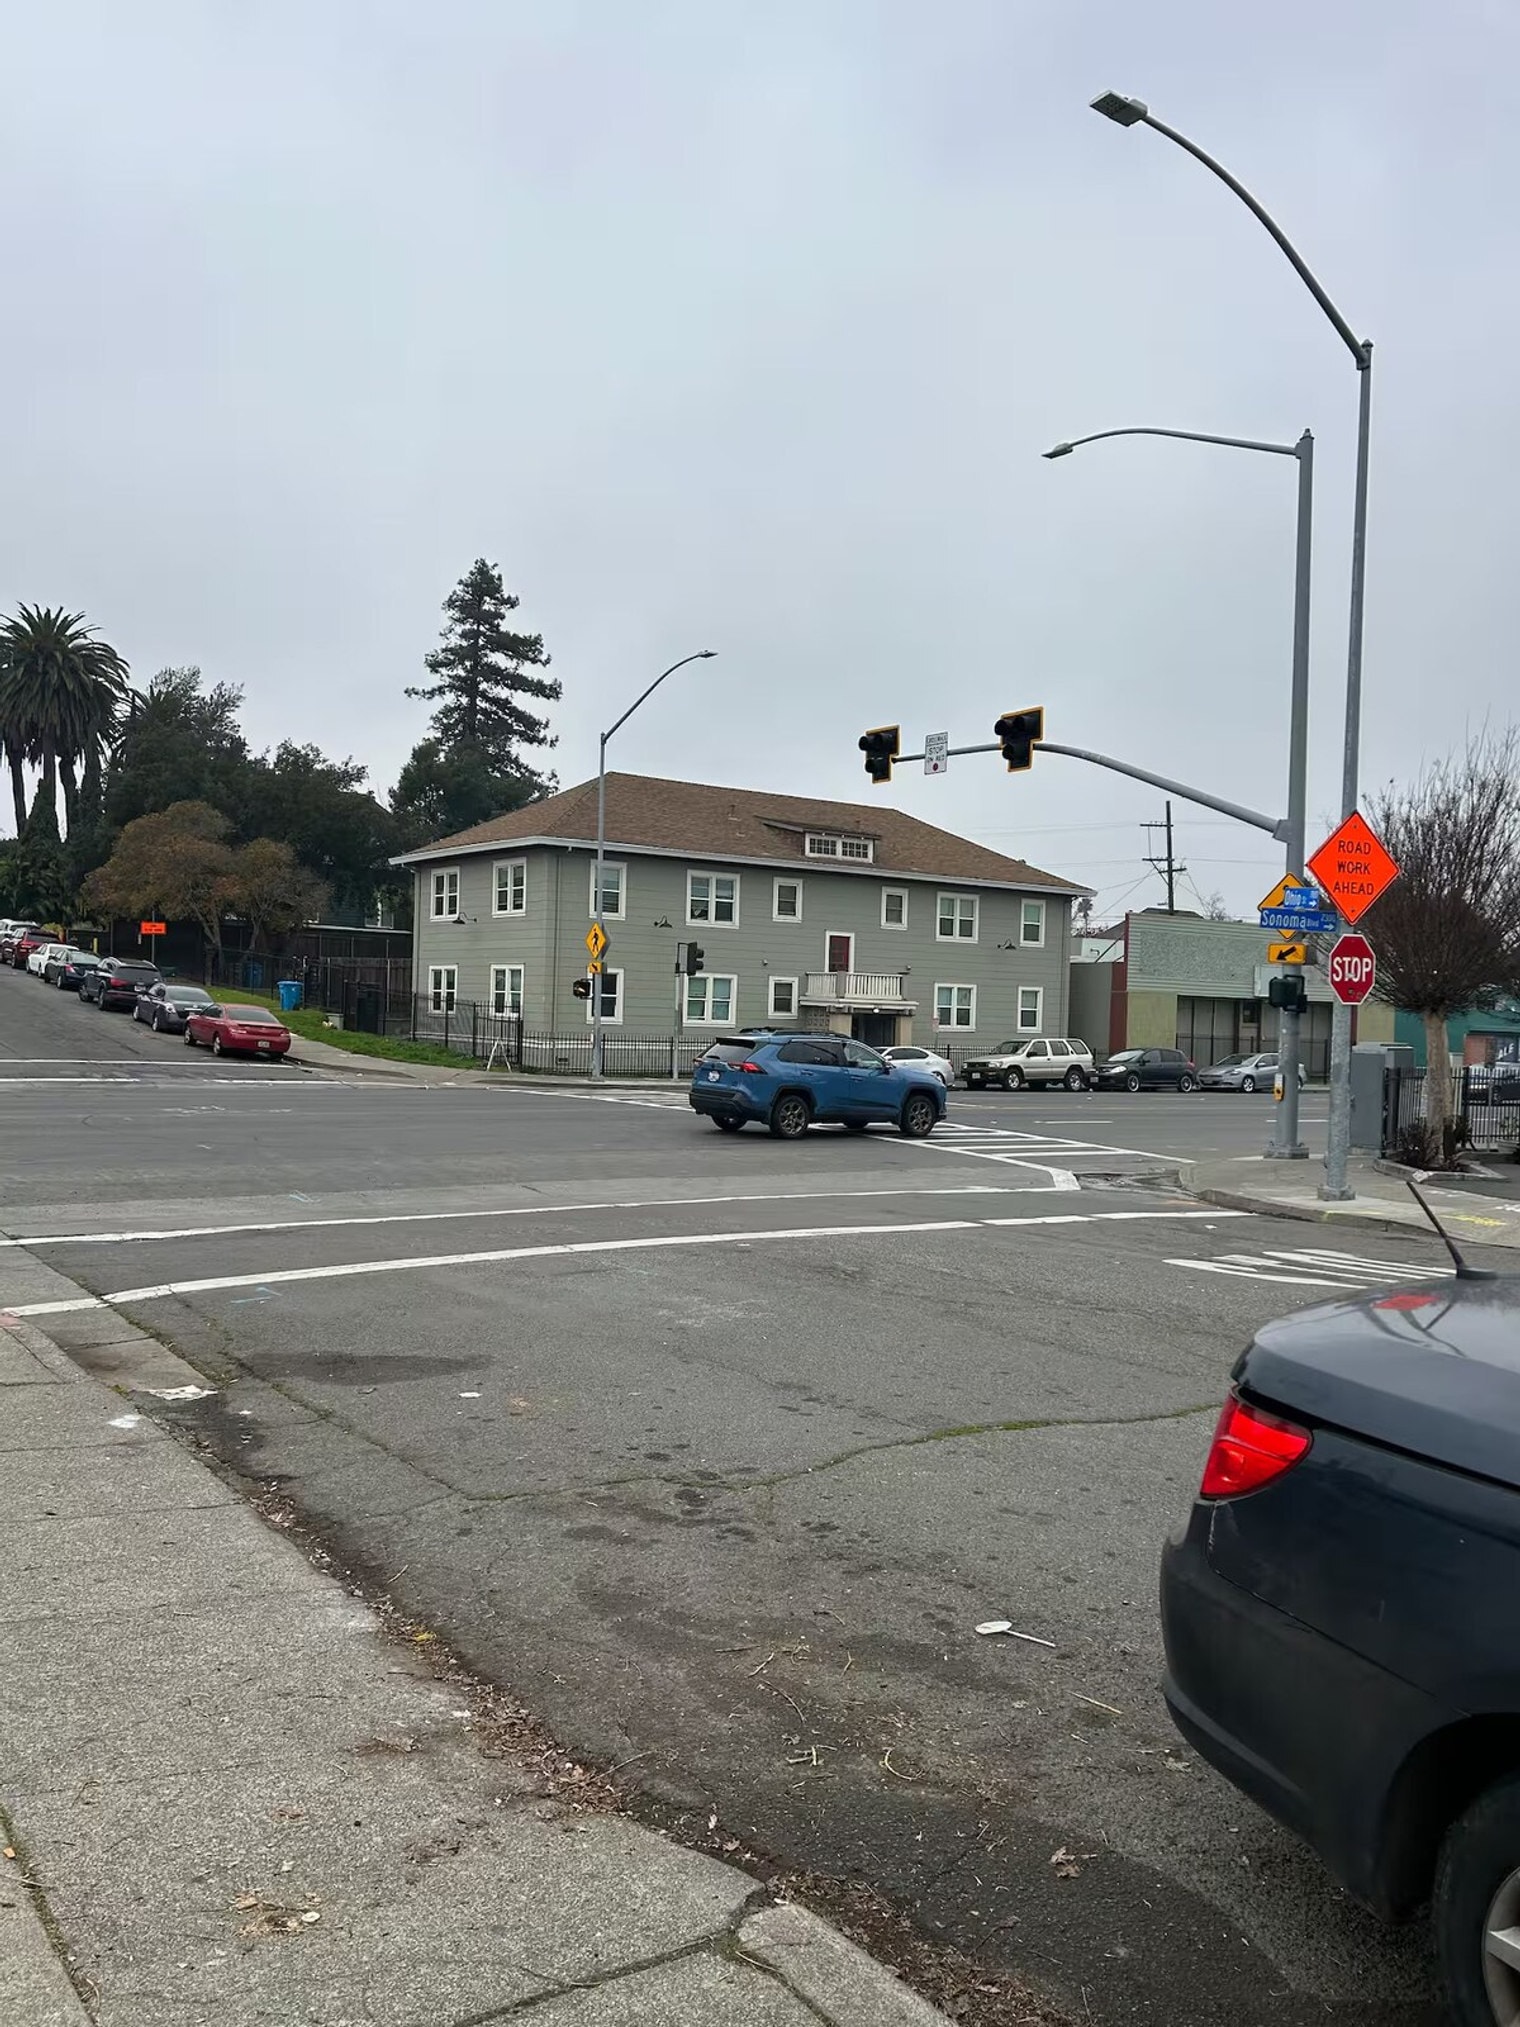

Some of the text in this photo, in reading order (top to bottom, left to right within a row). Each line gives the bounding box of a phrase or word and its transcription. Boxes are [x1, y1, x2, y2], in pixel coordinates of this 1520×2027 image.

[1338, 840, 1371, 855] ROAD
[1337, 860, 1371, 875] WORK
[1333, 880, 1374, 895] AHEAD
[1284, 890, 1301, 906] Ohio
[1261, 910, 1306, 928] Sonoma
[1332, 956, 1372, 983] STOP
